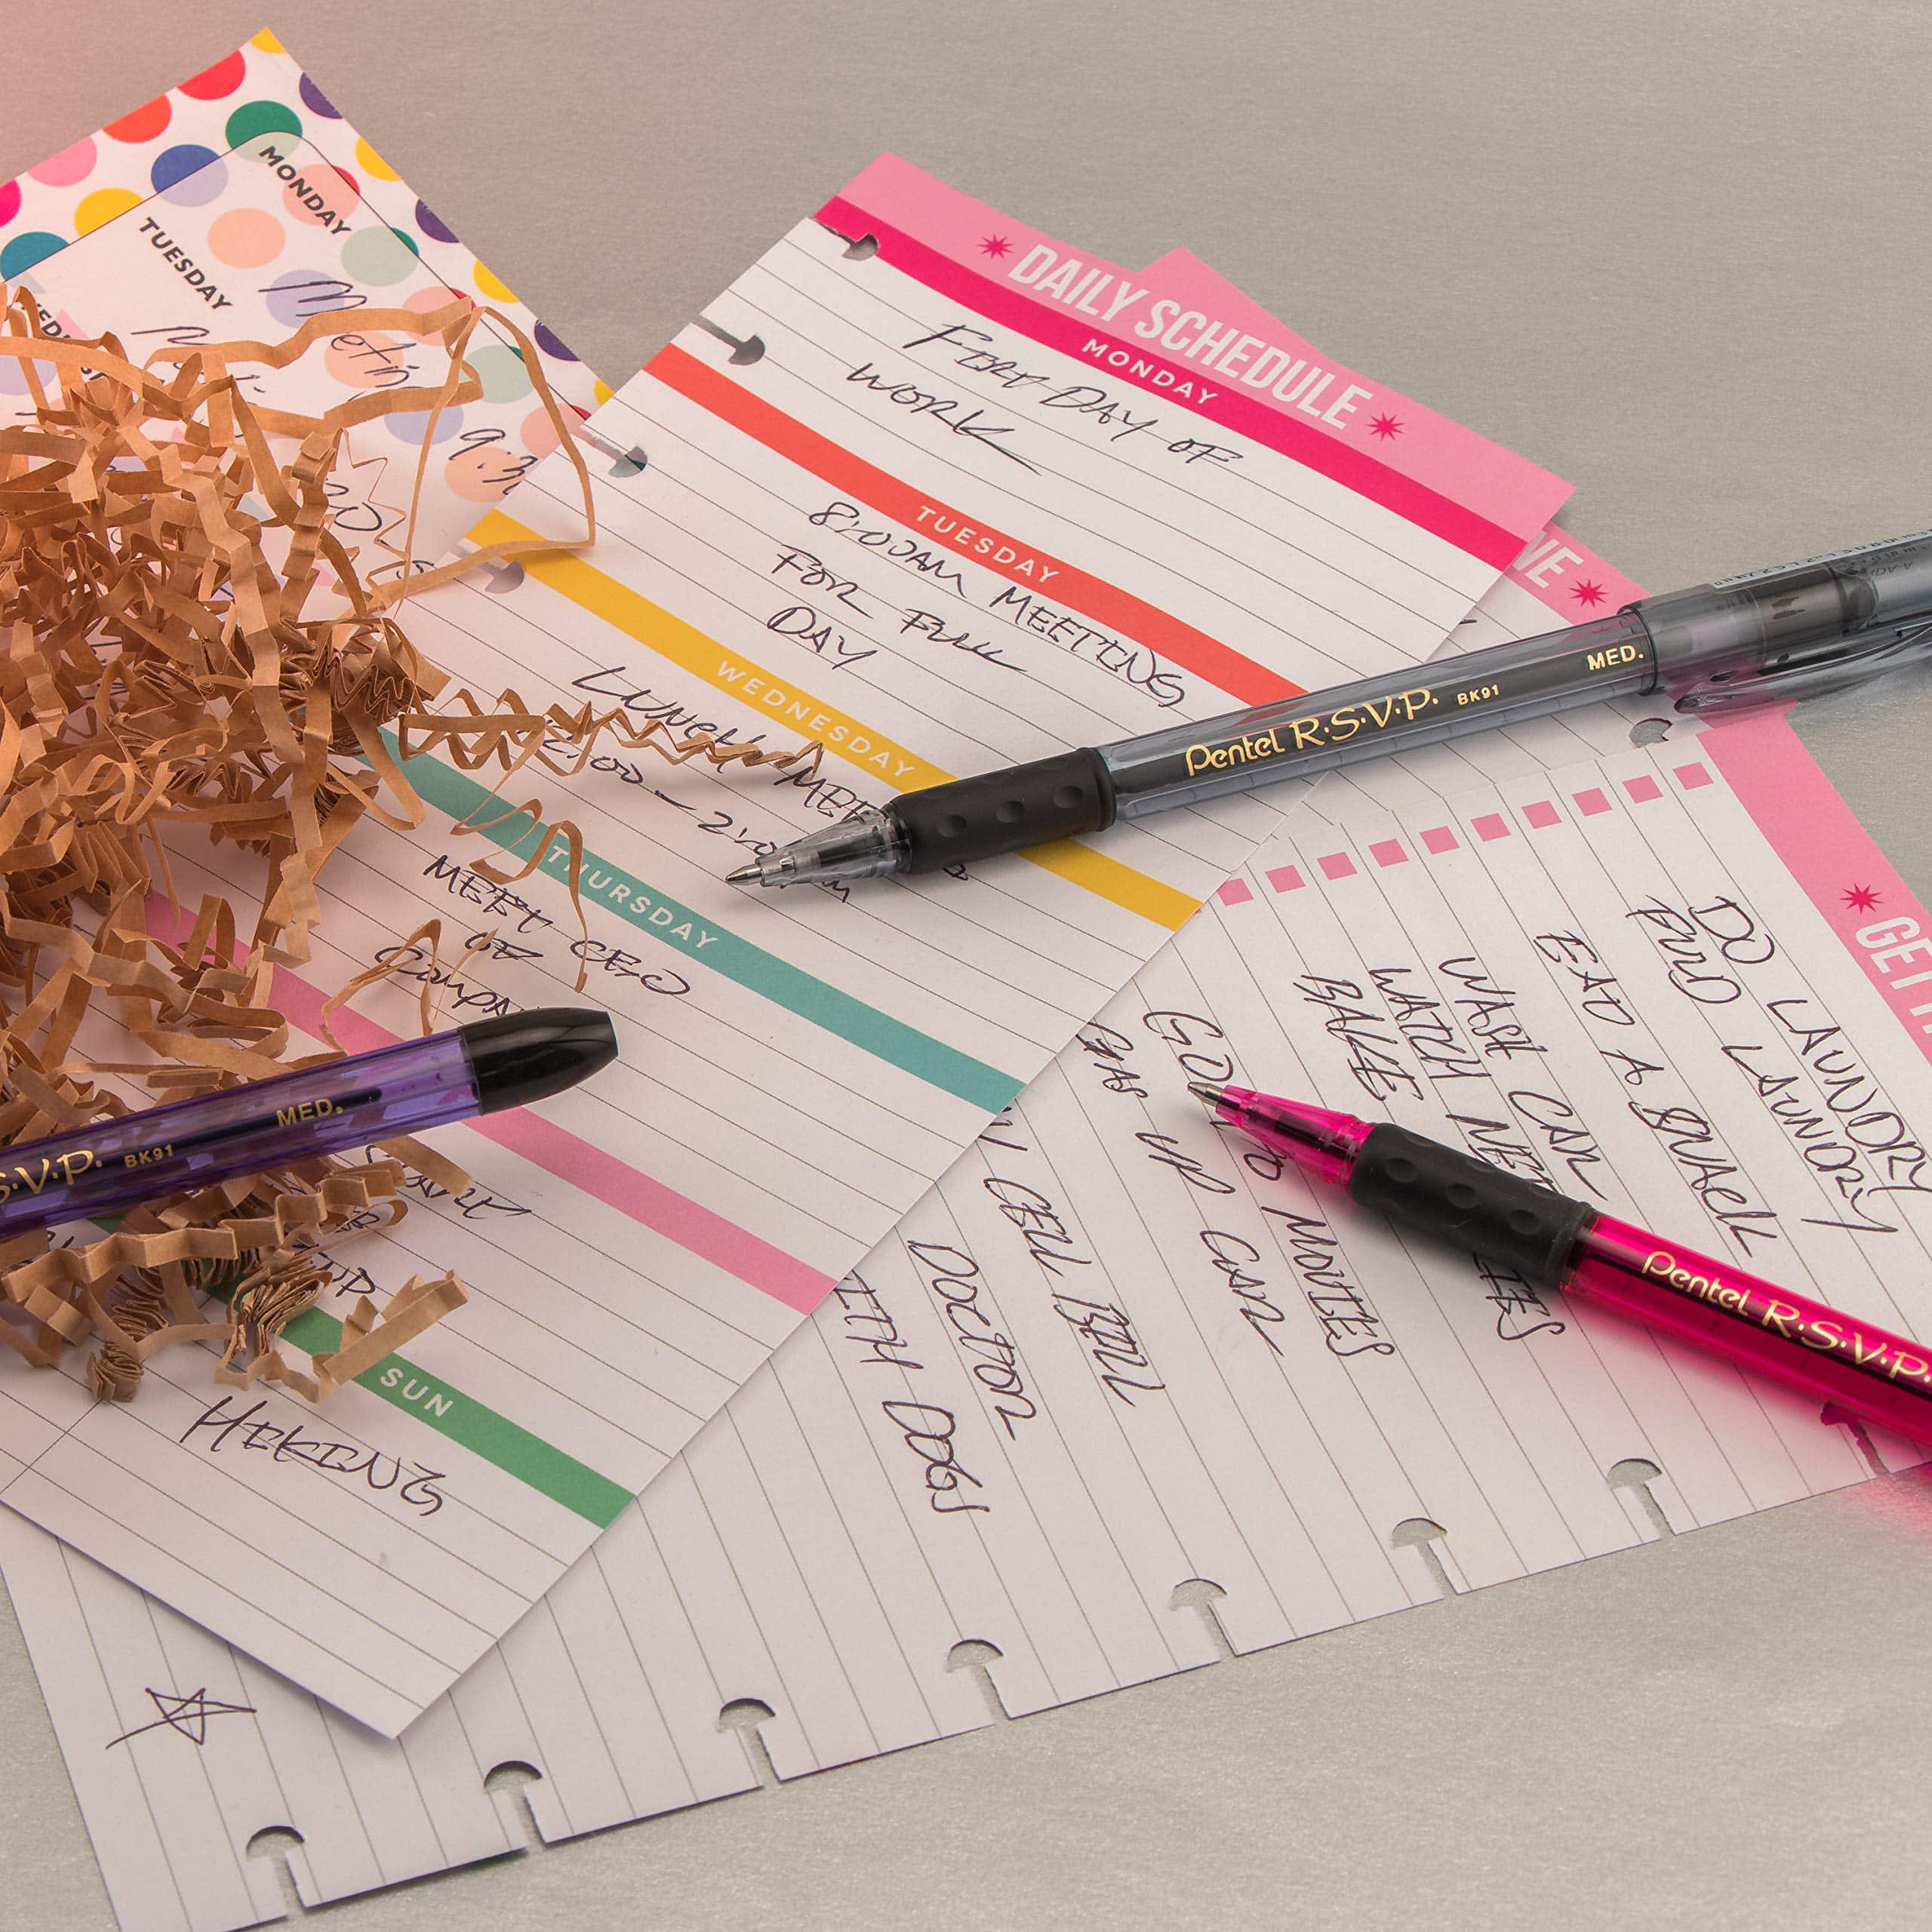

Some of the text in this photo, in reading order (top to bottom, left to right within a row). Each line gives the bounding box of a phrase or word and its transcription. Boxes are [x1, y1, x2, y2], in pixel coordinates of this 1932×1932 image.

[258, 146, 352, 235] MONDAY
[139, 217, 233, 311] TUESDAY
[1009, 245, 1373, 429] DAILY SCHEDULE
[1082, 339, 1218, 406] MONDAY
[847, 362, 1041, 475] WORK
[1039, 386, 1158, 441] DAY
[1168, 438, 1244, 465] OF
[917, 505, 1060, 583] TUESDAY
[767, 606, 878, 669] DAY
[771, 545, 1028, 672] FOR FULL
[717, 660, 918, 779] WEDNESDAY
[1185, 729, 1285, 777] Pentel
[1457, 685, 1500, 706] BK91
[1587, 645, 1644, 671] MED.
[422, 854, 691, 996] MEET CEO
[1293, 974, 1424, 1102] BAKE
[1368, 968, 1492, 1079] WATCH
[1534, 930, 1635, 1026] EAT
[1600, 1049, 1665, 1085] A
[1688, 896, 1932, 1198] DO LAUNDRY
[276, 1097, 345, 1128] MED.
[1438, 957, 1548, 1060] WASH
[1509, 1091, 1607, 1201] CAR
[1721, 1045, 1899, 1232] LAUNDRY
[124, 1143, 174, 1169] BK91
[1143, 1011, 1235, 1081] GO
[1260, 1206, 1395, 1357] MOVIES
[983, 1177, 1092, 1278] CELL
[1051, 1293, 1167, 1408] BILL
[1135, 1132, 1236, 1194] UP
[1200, 1230, 1285, 1357] CAR
[1642, 1251, 1751, 1316] Pentel
[380, 1367, 454, 1419] SUN
[832, 1269, 990, 1513] ITH DOGS
[907, 1239, 1038, 1441] DOCTOR
